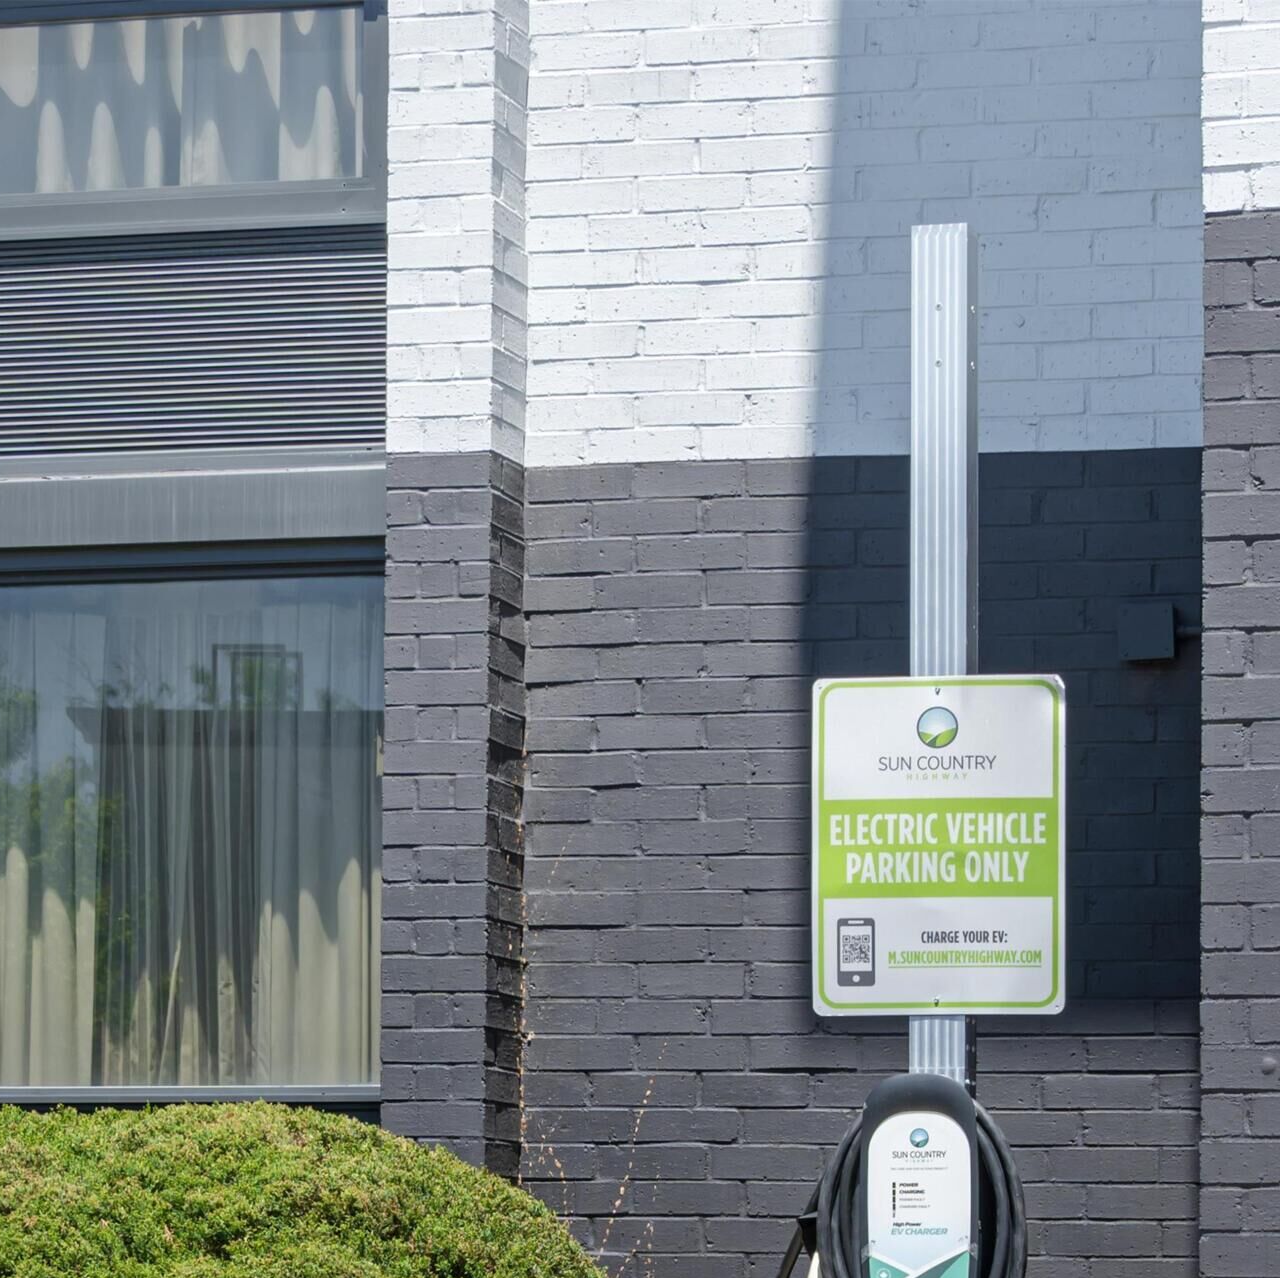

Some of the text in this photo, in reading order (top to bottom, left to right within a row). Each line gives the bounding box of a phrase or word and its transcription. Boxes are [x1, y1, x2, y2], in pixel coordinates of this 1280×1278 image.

[878, 755, 997, 771] SUN COUNTRY
[906, 773, 968, 781] HIGHWAY
[830, 812, 1047, 846] ELECTRIC VEHICLE
[846, 851, 1029, 884] PARKING ONLY
[921, 930, 1008, 944] CHARGE YOUR EV:
[888, 950, 1042, 965] M.SUNCOUNTRYHIGHWAY.COM
[892, 1150, 946, 1159] SUN COUNTRY
